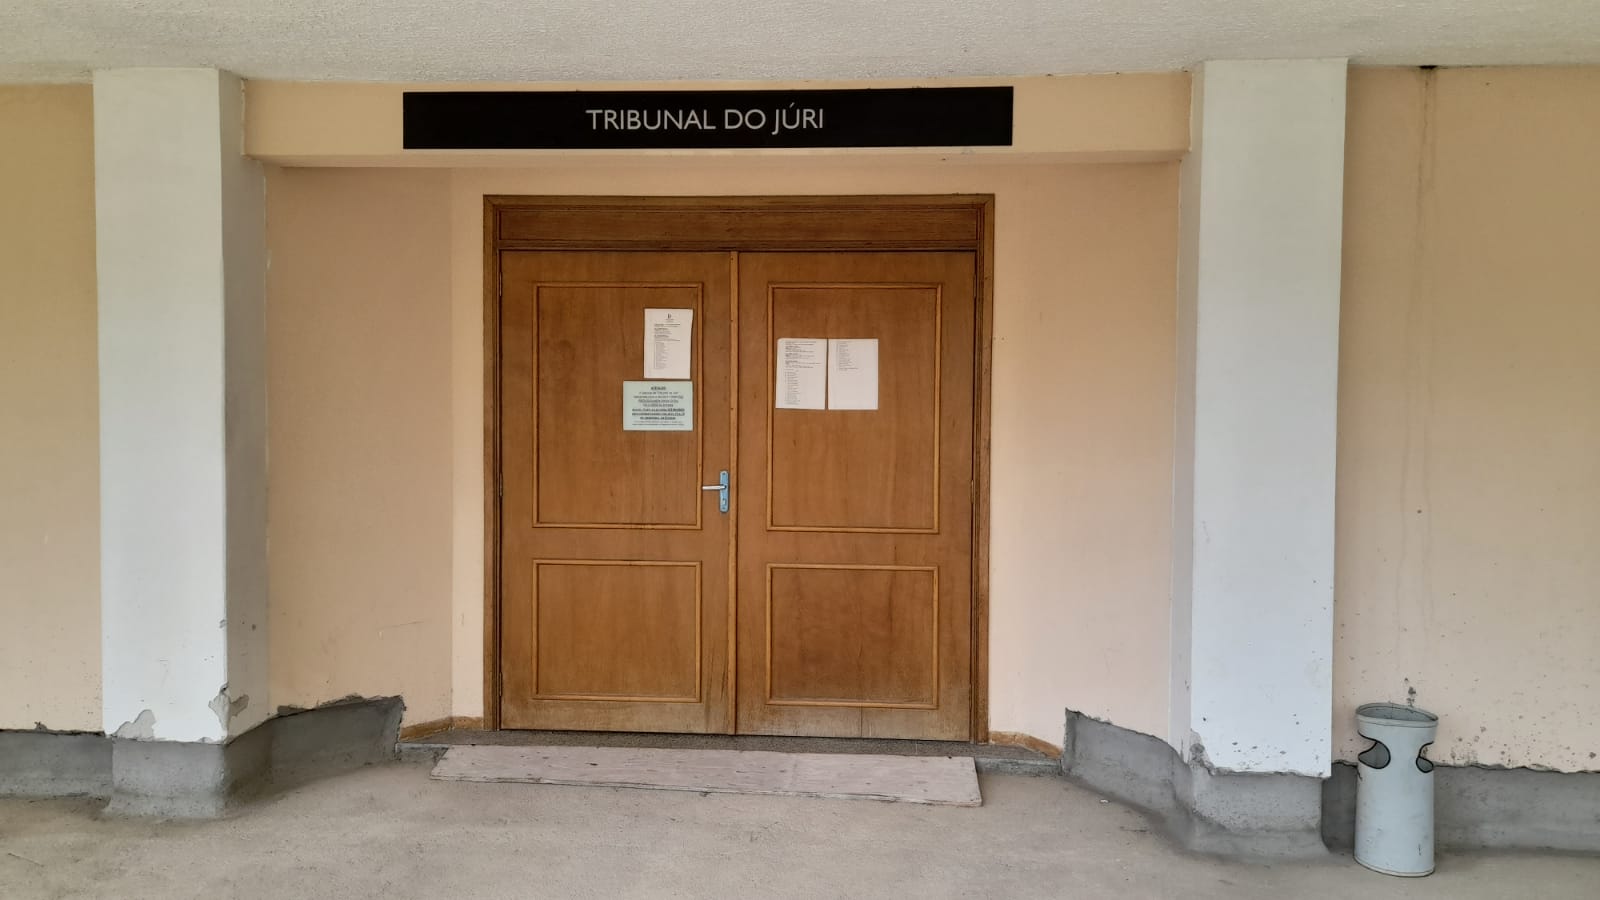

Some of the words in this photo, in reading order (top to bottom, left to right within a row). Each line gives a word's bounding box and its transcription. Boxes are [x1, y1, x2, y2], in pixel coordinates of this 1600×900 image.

[585, 109, 717, 130] TRIBUNAL
[724, 108, 766, 130] DO
[771, 102, 823, 136] JÚRI
